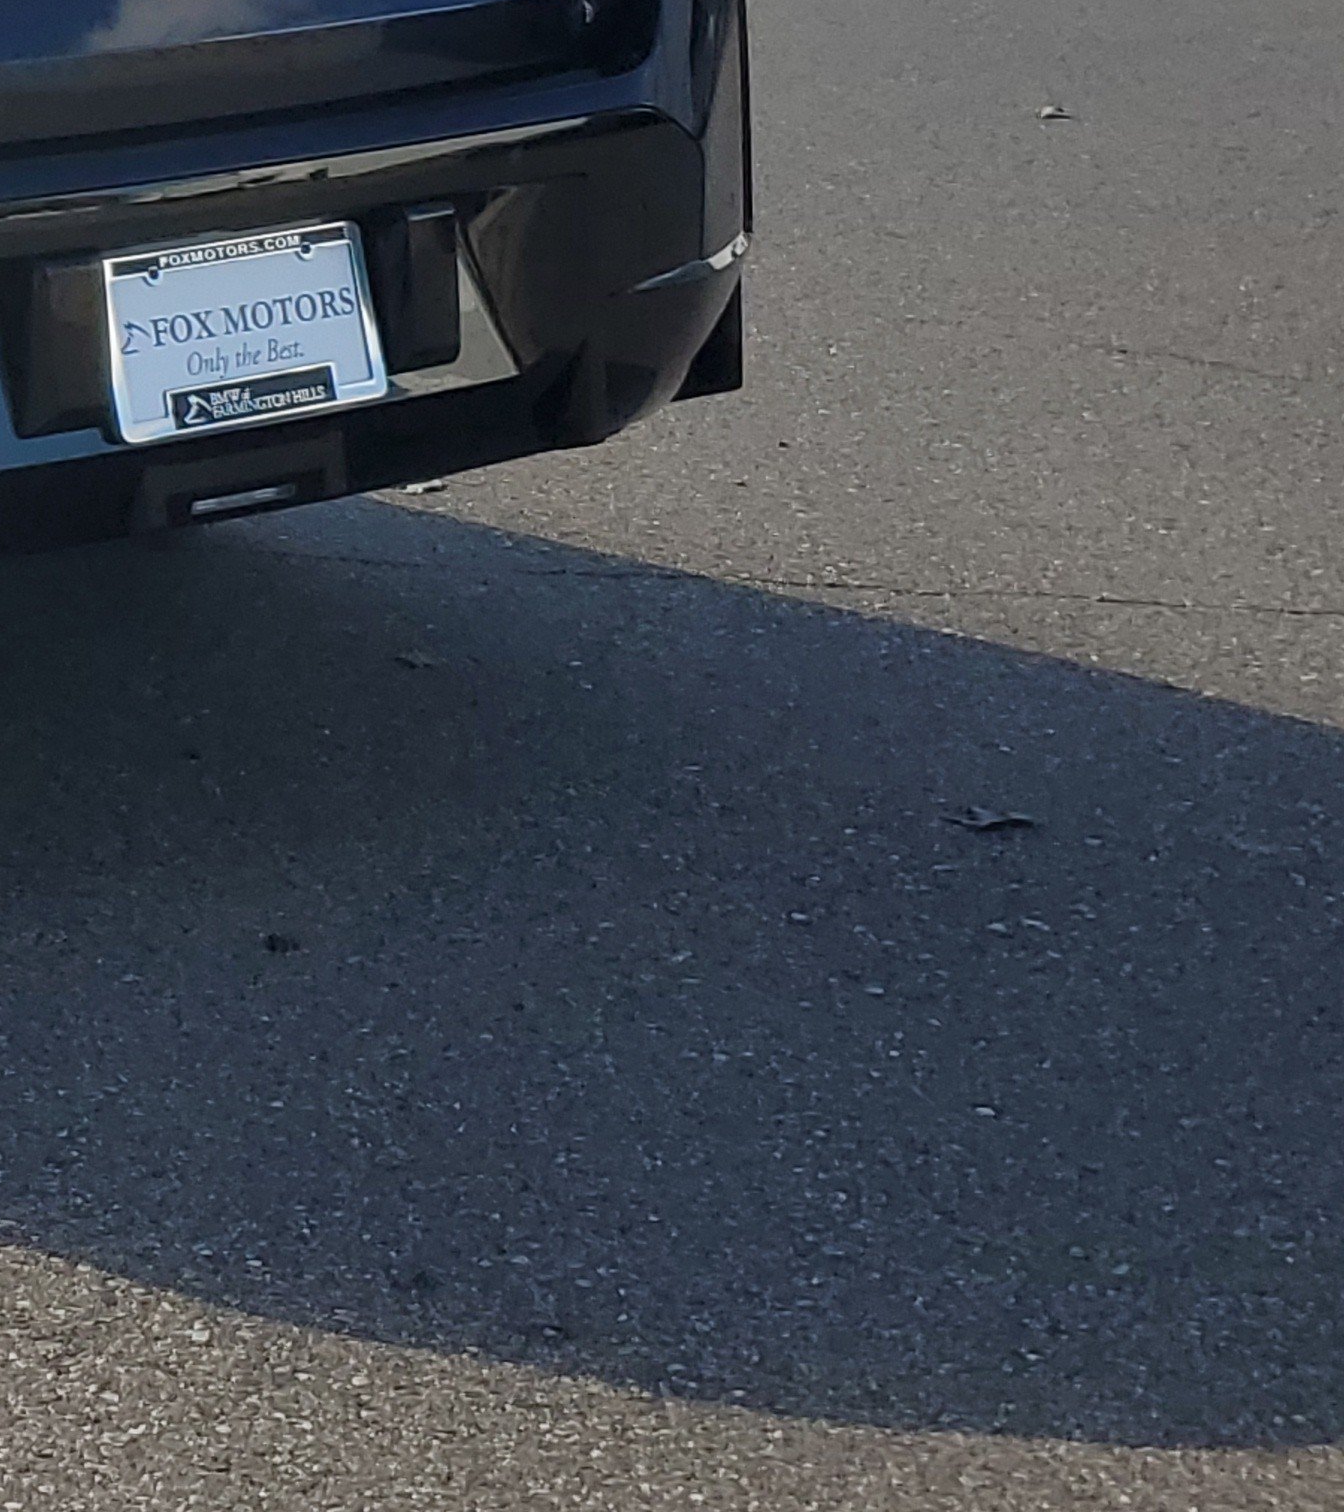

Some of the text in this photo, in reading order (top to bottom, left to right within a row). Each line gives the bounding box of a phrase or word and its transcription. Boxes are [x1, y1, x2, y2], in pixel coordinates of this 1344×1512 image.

[158, 235, 301, 268] FOXMOTORS.COM
[149, 287, 355, 347] FOX MOTORS
[186, 338, 305, 379] Only the Best.
[210, 388, 241, 406] BMW
[292, 385, 326, 404] HILLS
